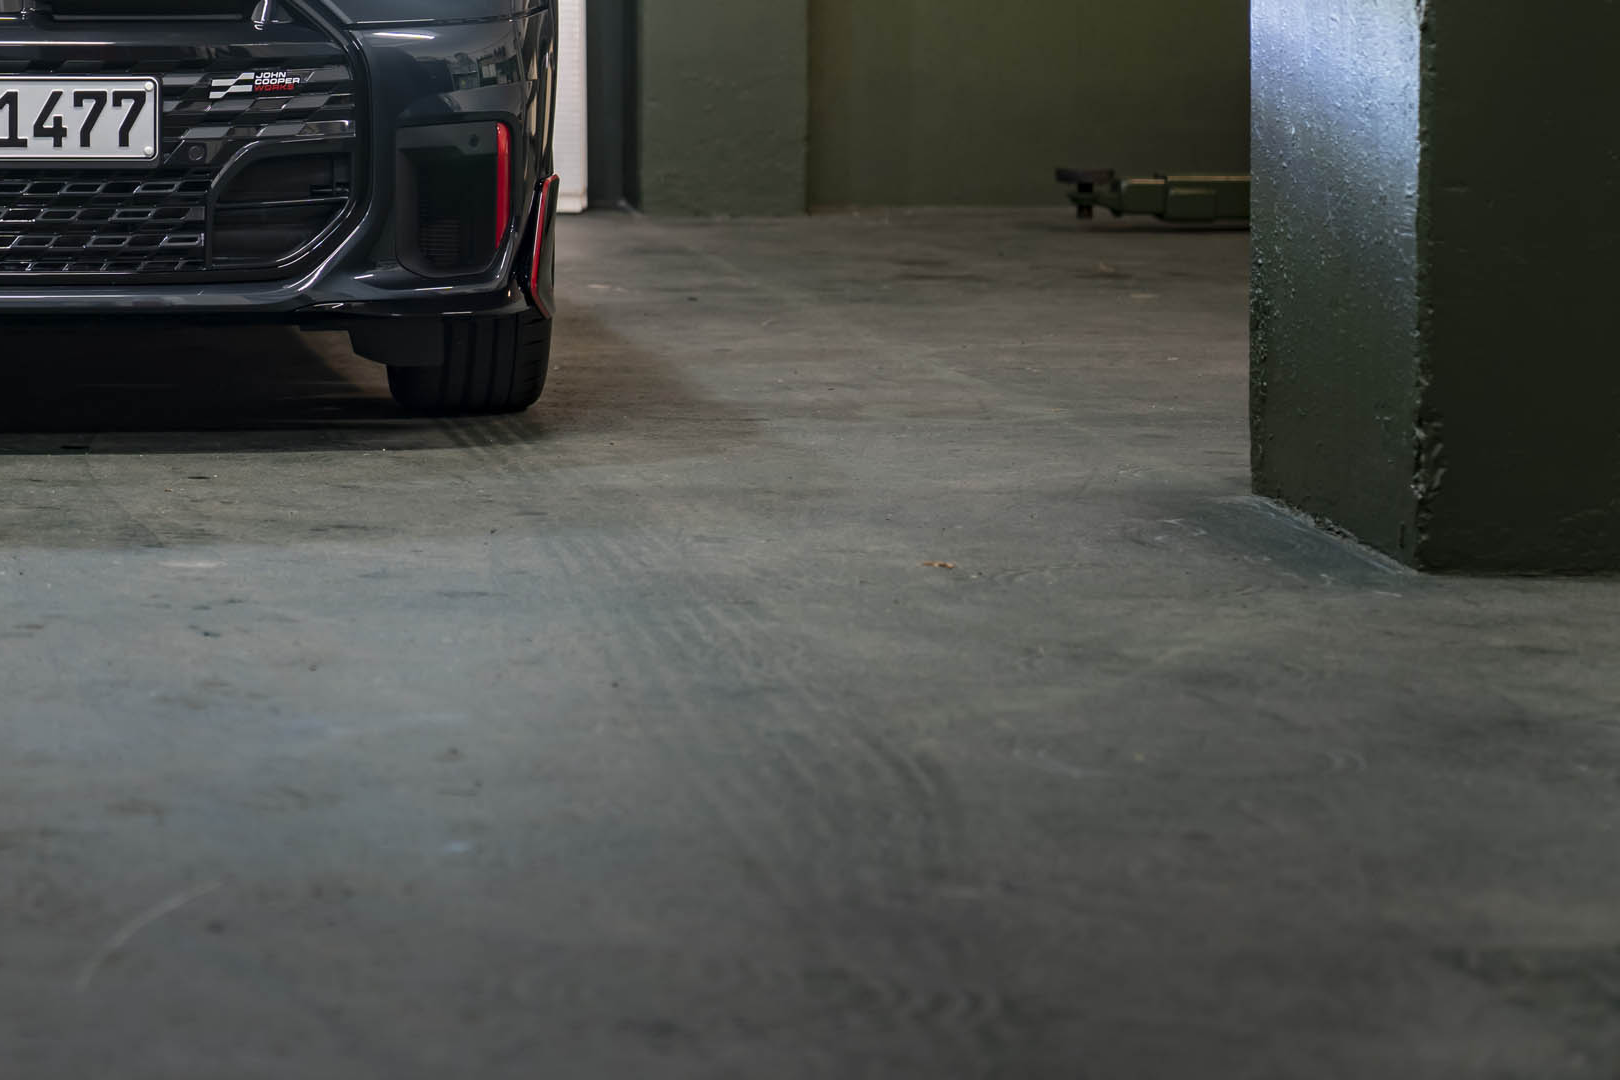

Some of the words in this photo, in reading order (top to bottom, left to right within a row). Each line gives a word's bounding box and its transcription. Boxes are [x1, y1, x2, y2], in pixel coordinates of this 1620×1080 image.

[255, 71, 287, 79] JOHN
[254, 77, 300, 85] COOPER
[254, 84, 295, 92] WORKS
